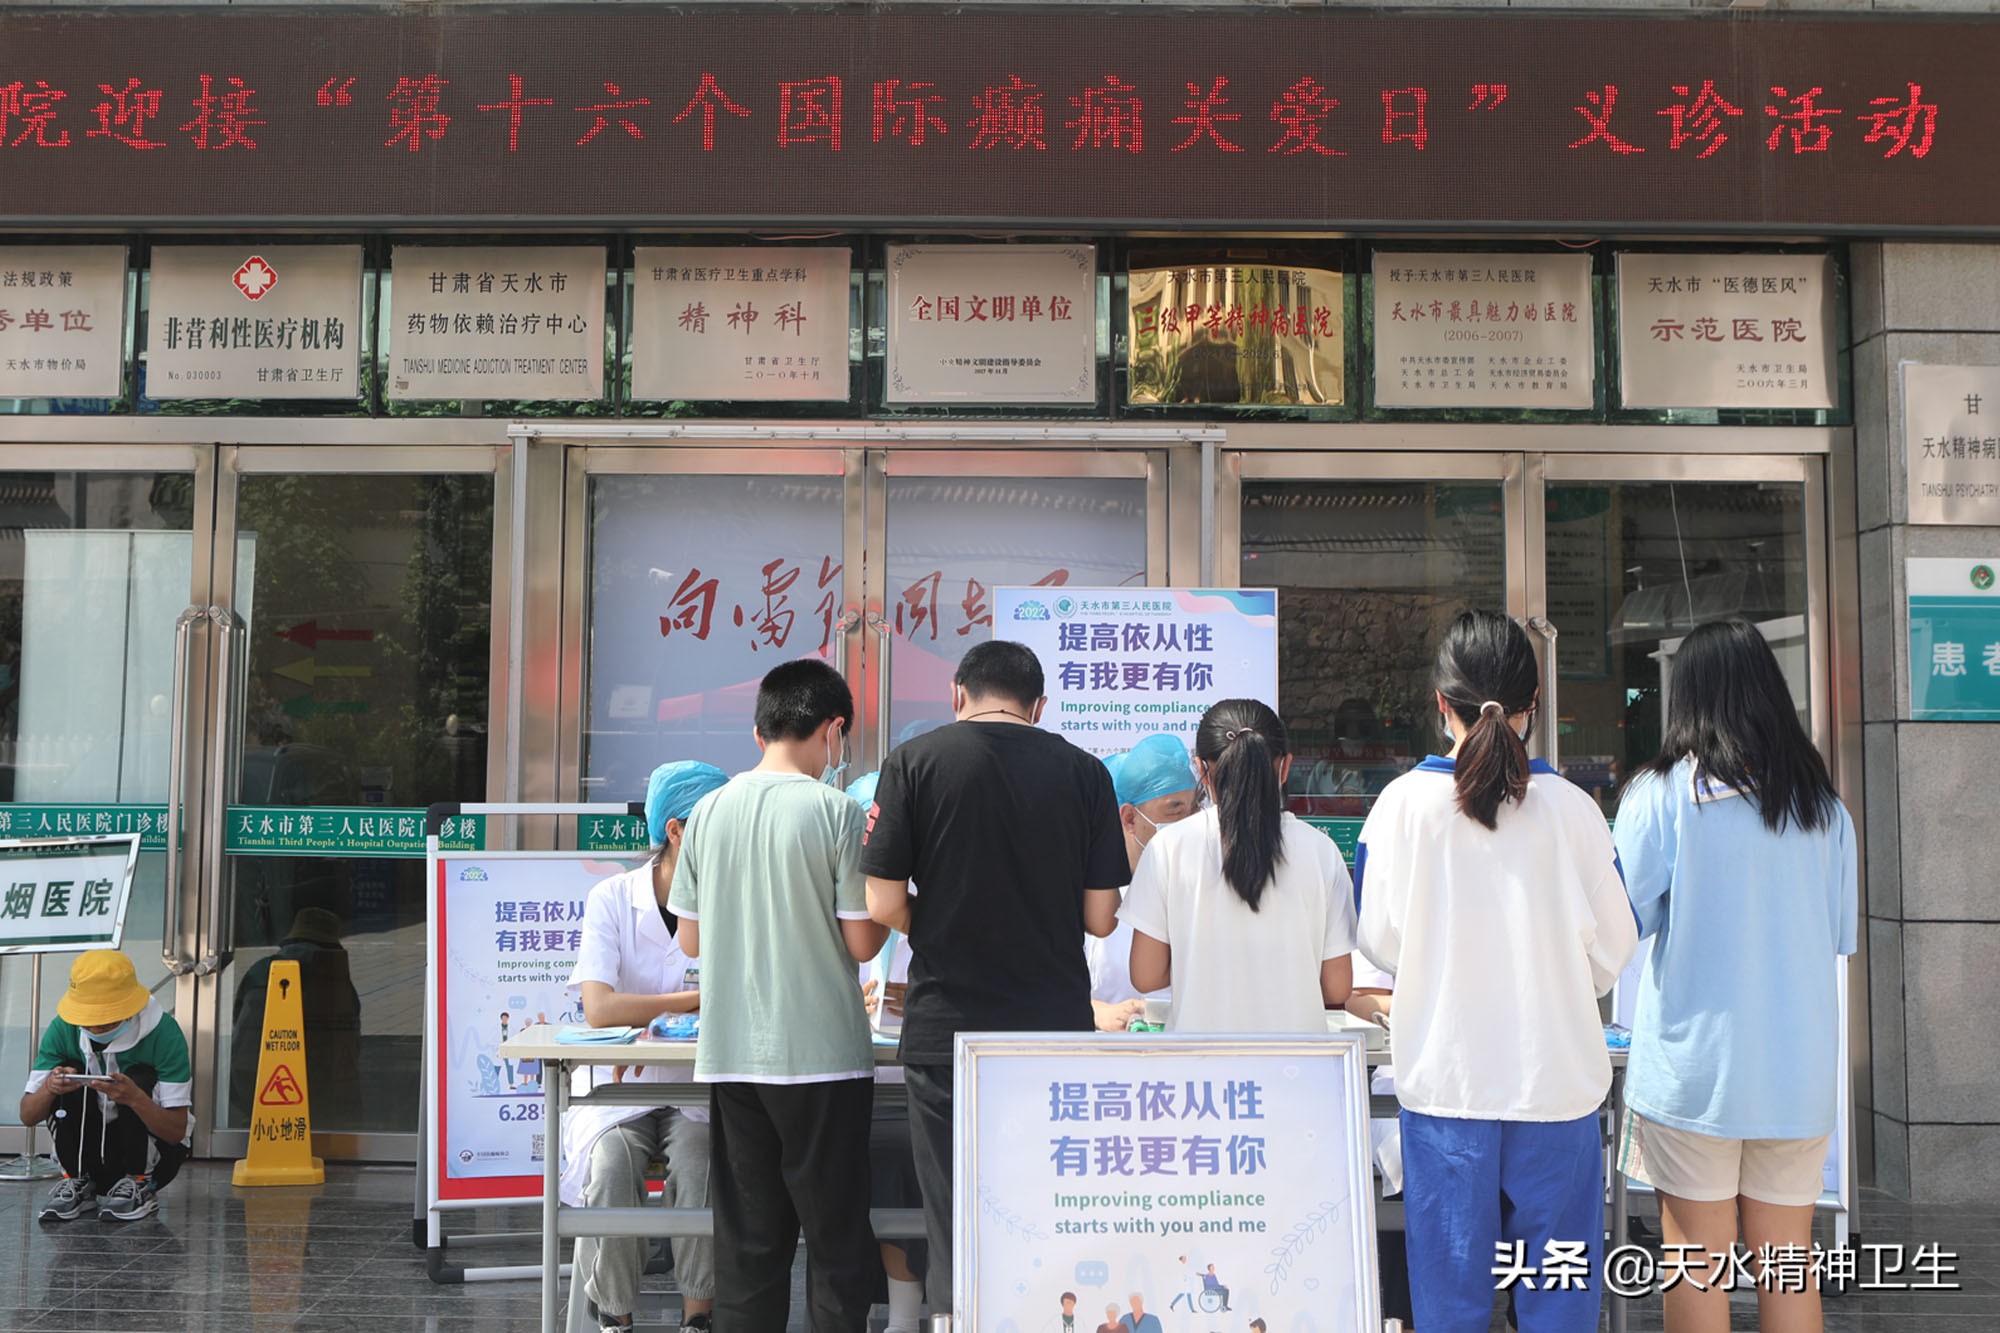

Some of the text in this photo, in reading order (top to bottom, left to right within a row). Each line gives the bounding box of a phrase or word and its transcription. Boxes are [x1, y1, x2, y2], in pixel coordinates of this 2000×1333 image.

[3, 271, 73, 287] 法规政策
[429, 272, 567, 293] 甘肃省天水市
[651, 267, 807, 282] 甘肃省医疗卫生重点学科
[1168, 269, 1307, 286] 天水市第三人民医院
[910, 295, 1073, 322] 全国文明单位
[1391, 300, 1577, 323] 天水市最具魅力的医院
[408, 313, 587, 335] 药物依赖治疗中心
[678, 301, 806, 336] 精神科
[1139, 300, 1334, 339] 三级甲等精神病医院
[163, 317, 345, 350] 非营利性医疗机构
[1651, 318, 1807, 342] 示范医院
[6, 358, 86, 371] 天水市物价局
[403, 358, 588, 374] TIANSHUI MEDICINE ADDICTION TREATMENT CENTER
[744, 356, 821, 366] 甘肃省卫生厅
[1736, 363, 1808, 374] 天水市卫生局
[256, 367, 344, 383] 甘肃省卫生厅
[1963, 393, 1982, 415] 甘
[1923, 436, 2000, 459] 天水精神病
[1921, 483, 1953, 497] TIANSHUI
[1019, 606, 1046, 618] 2022
[1080, 600, 1172, 611] 天水市第三人民医院
[1058, 622, 1214, 652] 提高依从性
[1058, 661, 1214, 691] 有我更有你
[1061, 701, 1131, 715] Improving
[1061, 720, 1099, 732] starts
[1102, 720, 1131, 732] with
[1135, 721, 1159, 733] you
[1162, 720, 1187, 732] and
[589, 819, 646, 840] 天水市
[238, 837, 275, 845] Tianshui
[278, 838, 302, 846] Third
[347, 839, 383, 849] Hospital
[387, 840, 427, 850] Outpatie
[438, 841, 475, 851] Building
[588, 842, 650, 850] Tianshui Thir
[1, 878, 113, 919] 烟医院
[497, 960, 551, 969] Improving
[498, 974, 526, 982] starts
[529, 973, 551, 982] with
[269, 1030, 297, 1039] CAUTION
[266, 1041, 300, 1051] WET FLOOR
[1049, 1080, 1265, 1121] 提高依从性
[499, 1104, 545, 1121] 6.28
[254, 1117, 306, 1141] 小心地滑
[1050, 1134, 1267, 1176] 有我更有你
[1055, 1190, 1265, 1211] Improving compliance
[1055, 1216, 1266, 1236] starts with you and me
